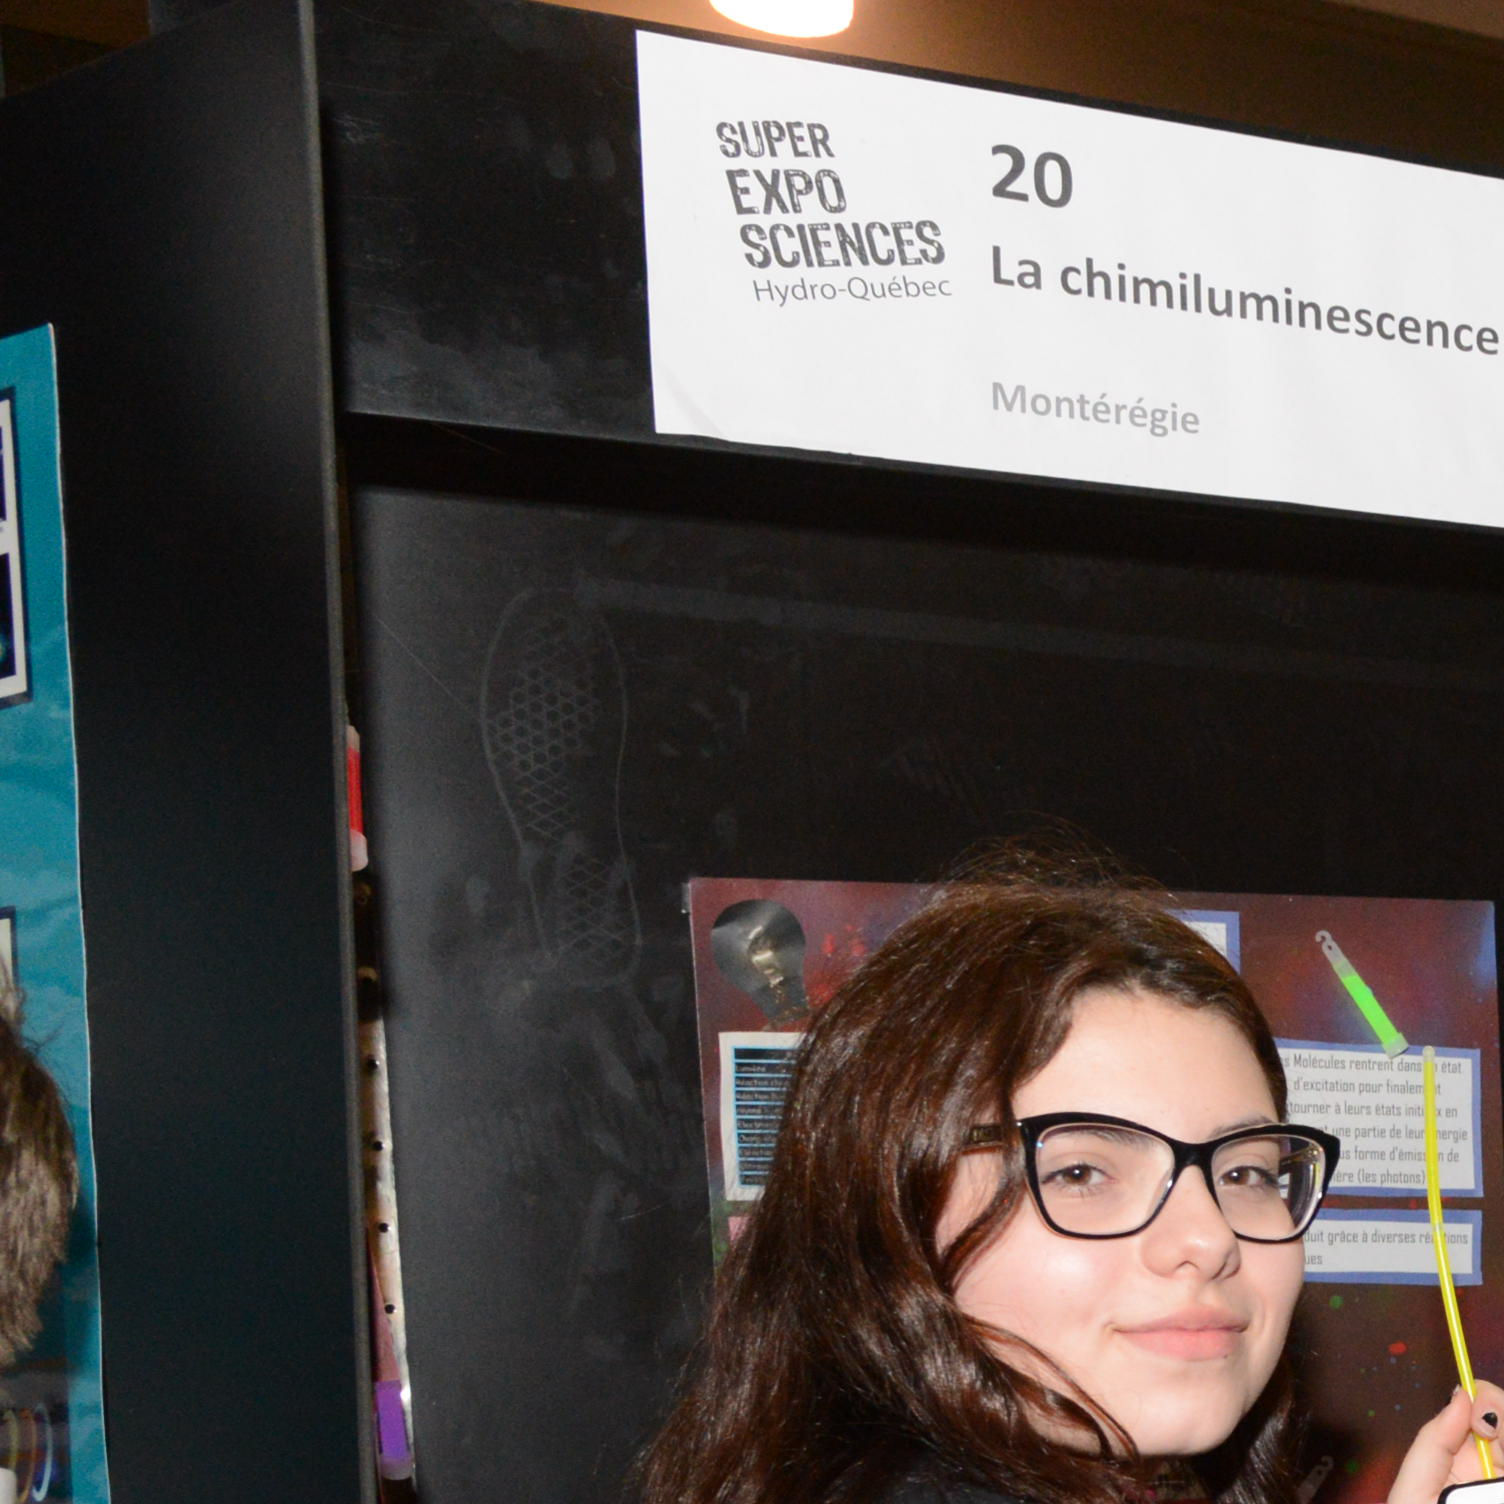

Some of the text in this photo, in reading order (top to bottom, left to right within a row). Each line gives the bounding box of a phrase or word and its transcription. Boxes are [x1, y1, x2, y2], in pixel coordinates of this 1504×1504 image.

[715, 121, 836, 161] SUPER
[990, 143, 1075, 209] 20
[725, 168, 847, 216] EXPO
[740, 220, 946, 272] SCIENCES
[752, 267, 952, 306] Hydro-Québec
[990, 244, 1502, 357] La chimiluminescence
[990, 381, 1202, 436] Montérégie
[1294, 1053, 1346, 1069] Molécules
[1349, 1057, 1394, 1072] rentrent
[1397, 1058, 1423, 1073] dans
[1441, 1061, 1462, 1074] état
[1293, 1077, 1355, 1093] d'excitation
[1358, 1082, 1384, 1097] pour
[1334, 1102, 1341, 1115] à
[1344, 1100, 1372, 1116] leurs
[1375, 1104, 1402, 1117] états
[1445, 1107, 1458, 1118] en
[1332, 1126, 1351, 1137] une
[1355, 1126, 1386, 1140] partie
[1389, 1124, 1402, 1138] de
[1355, 1146, 1386, 1160] forme
[1447, 1148, 1460, 1162] de
[1358, 1168, 1377, 1184] (les
[1380, 1169, 1426, 1185] photons)
[1327, 1231, 1359, 1247] grâce
[1361, 1230, 1368, 1243] à
[1371, 1229, 1416, 1244] diverses
